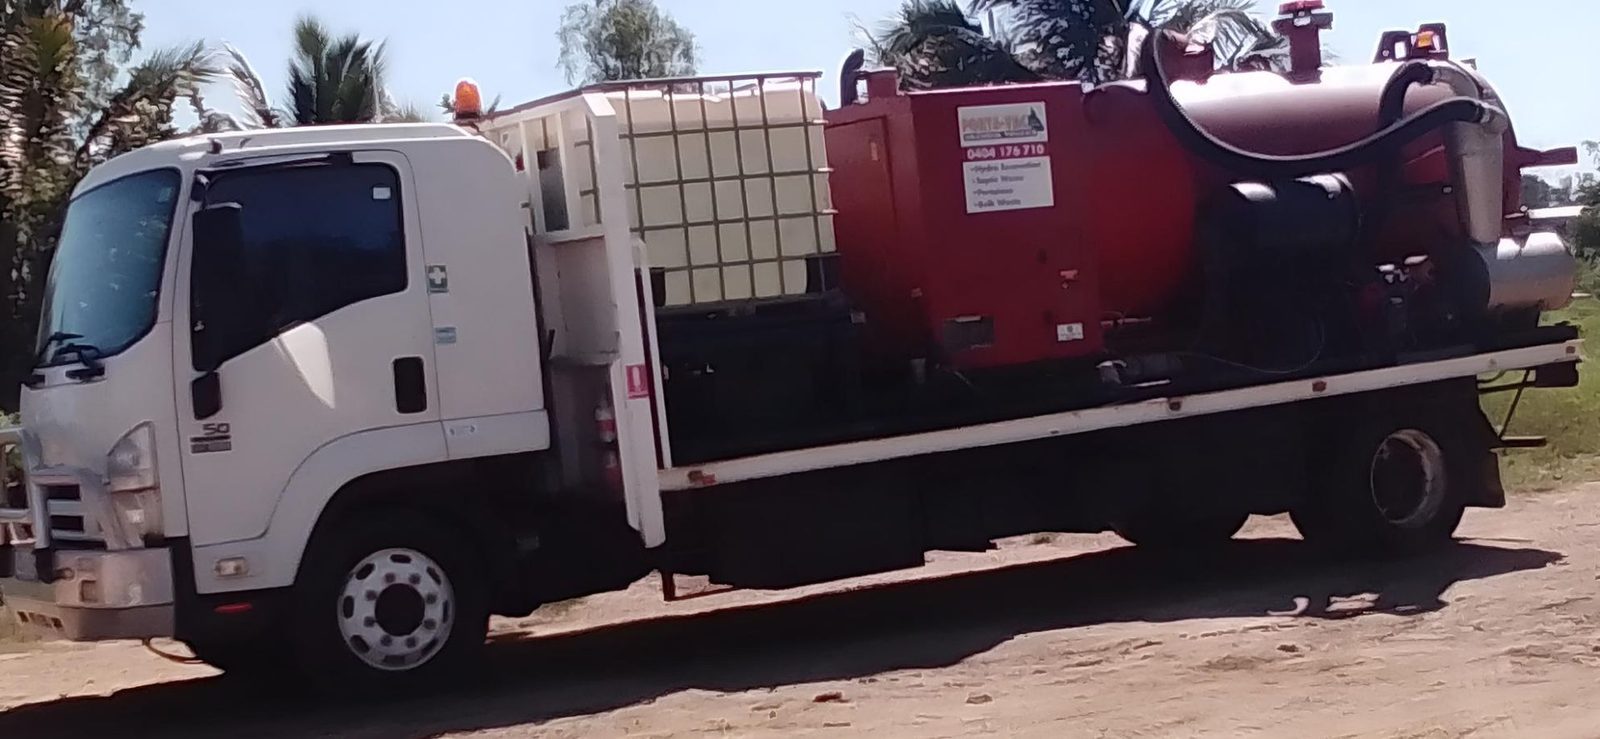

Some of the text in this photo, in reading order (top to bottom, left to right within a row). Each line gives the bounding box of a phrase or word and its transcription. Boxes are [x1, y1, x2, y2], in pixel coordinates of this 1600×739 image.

[967, 144, 1045, 160] 0404 176 710
